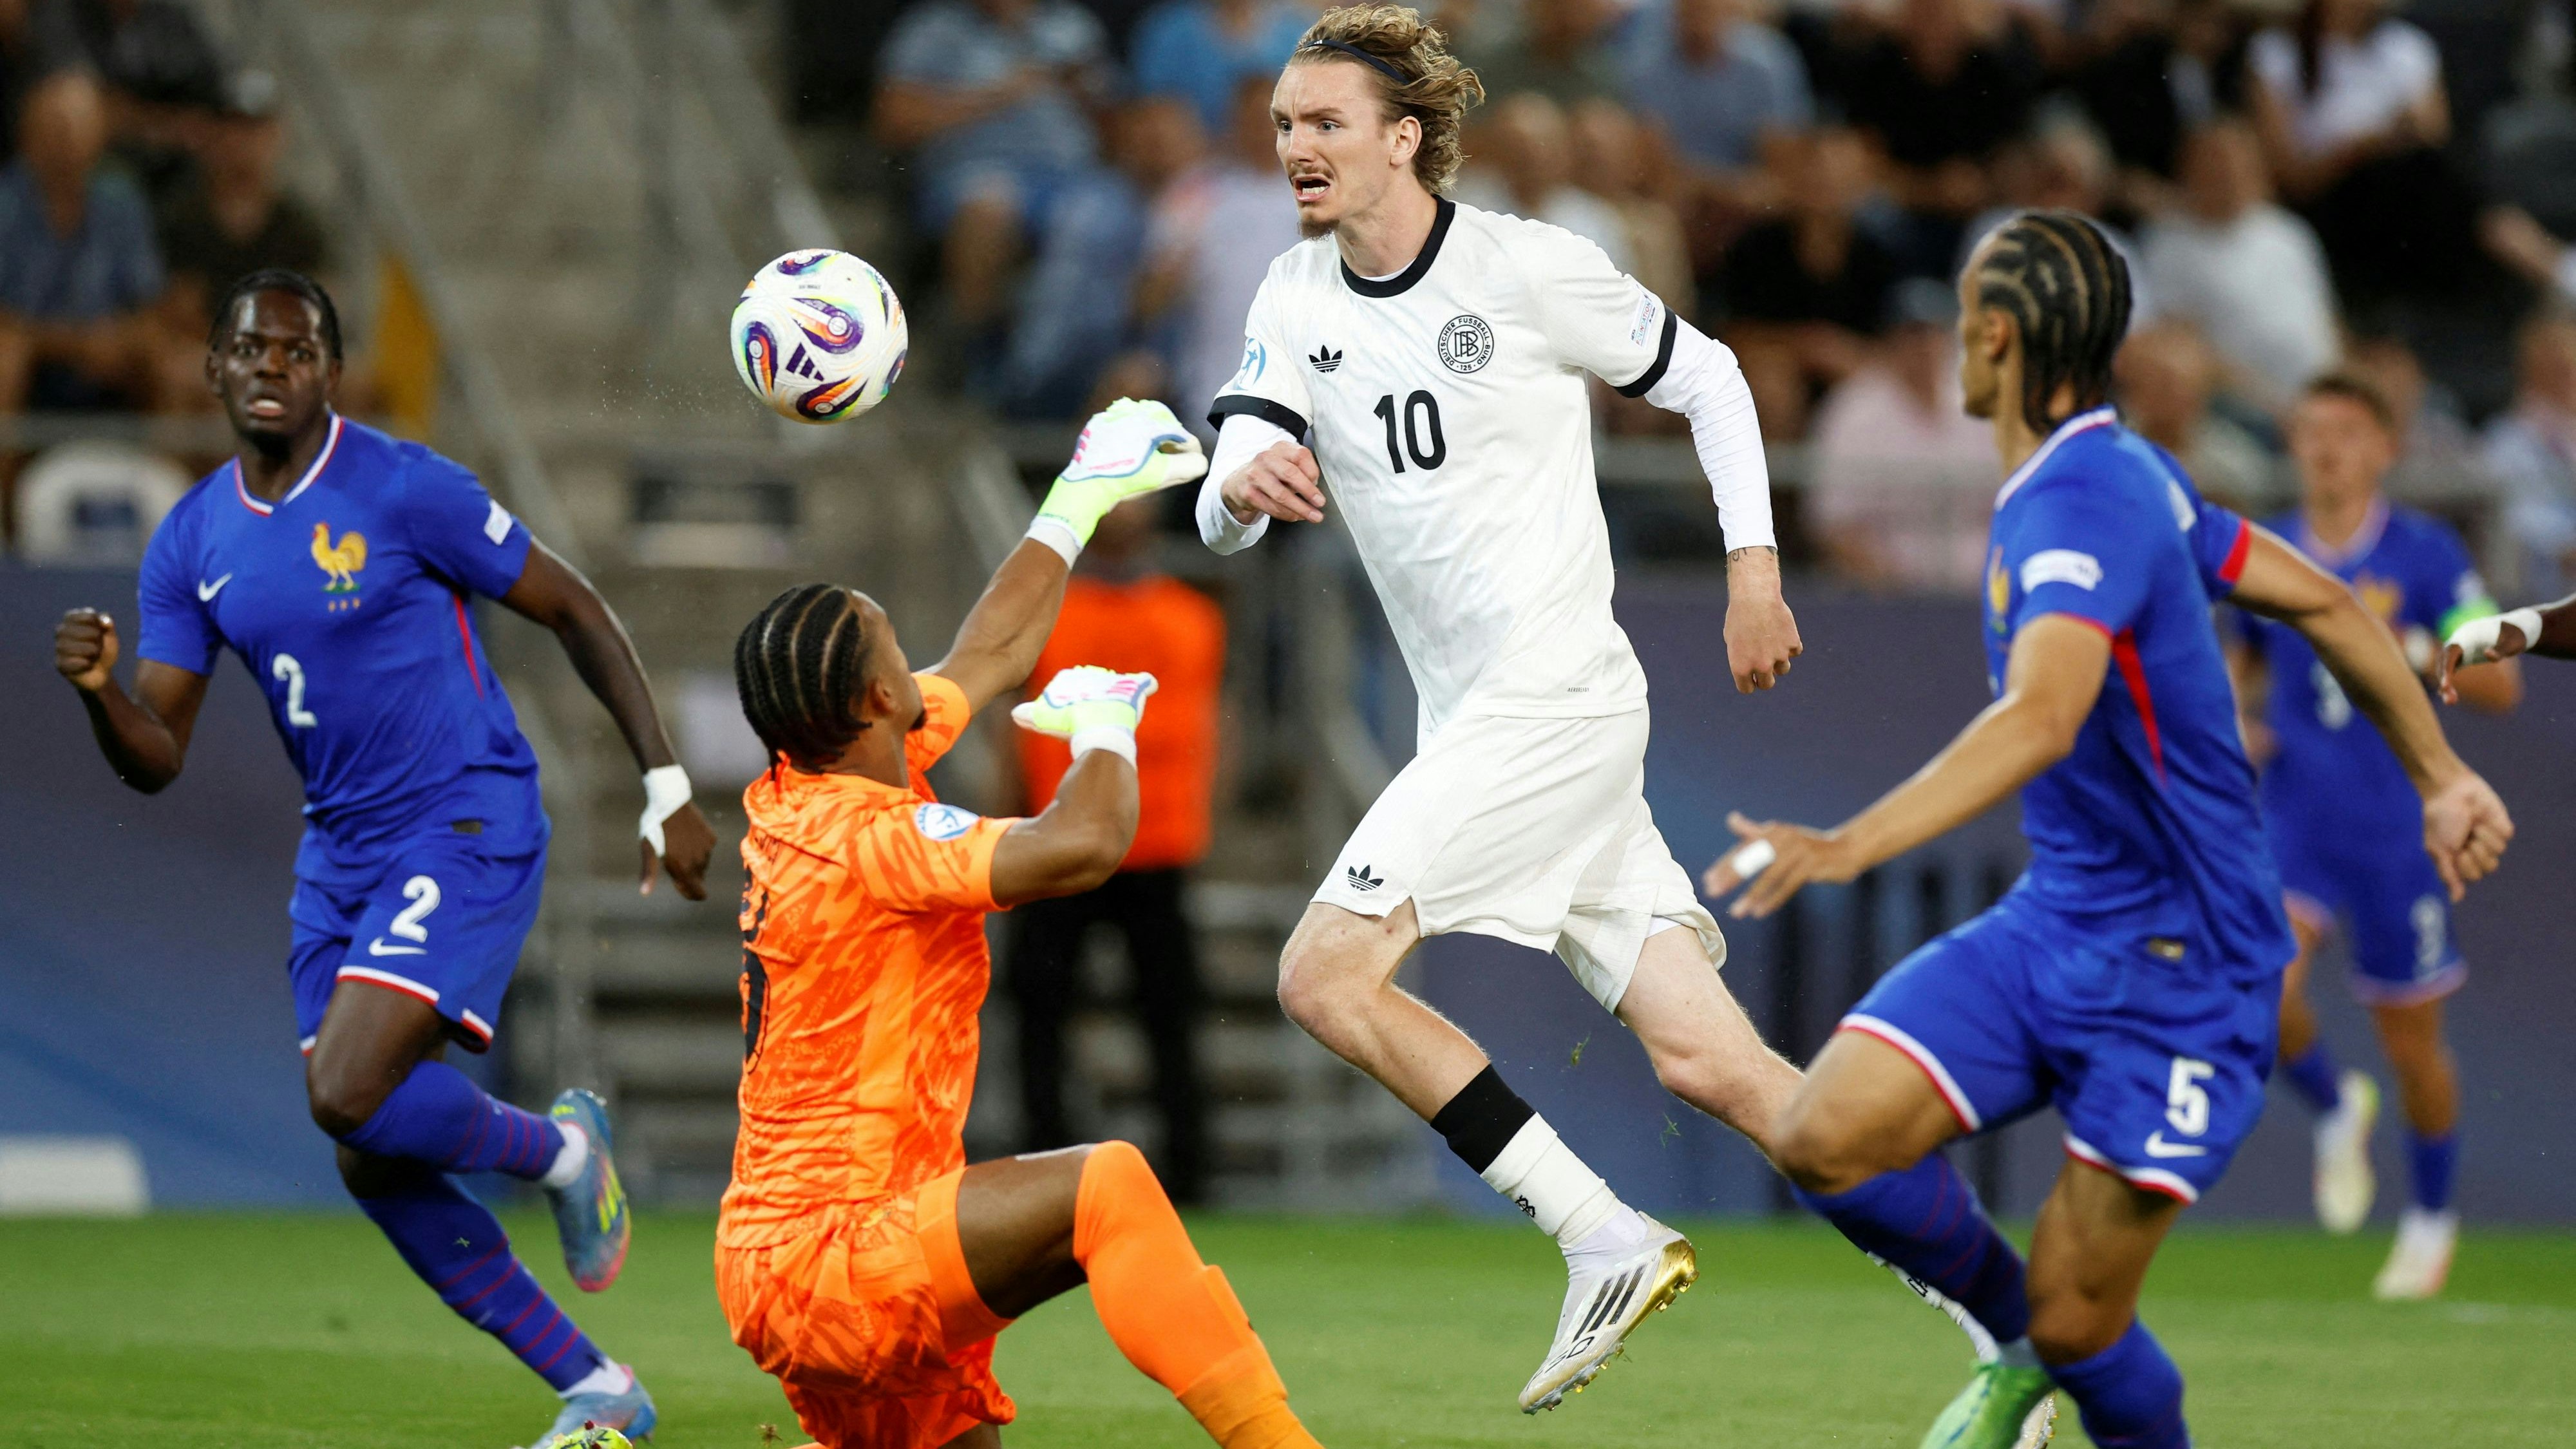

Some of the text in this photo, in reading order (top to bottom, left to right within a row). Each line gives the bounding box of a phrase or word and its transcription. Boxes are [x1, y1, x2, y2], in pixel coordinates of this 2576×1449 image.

[1441, 322, 1456, 366] DEUTSCHER
[1373, 390, 1446, 473] 10
[272, 653, 317, 728] 2
[389, 875, 441, 943] 2
[2164, 1055, 2215, 1138] 5
